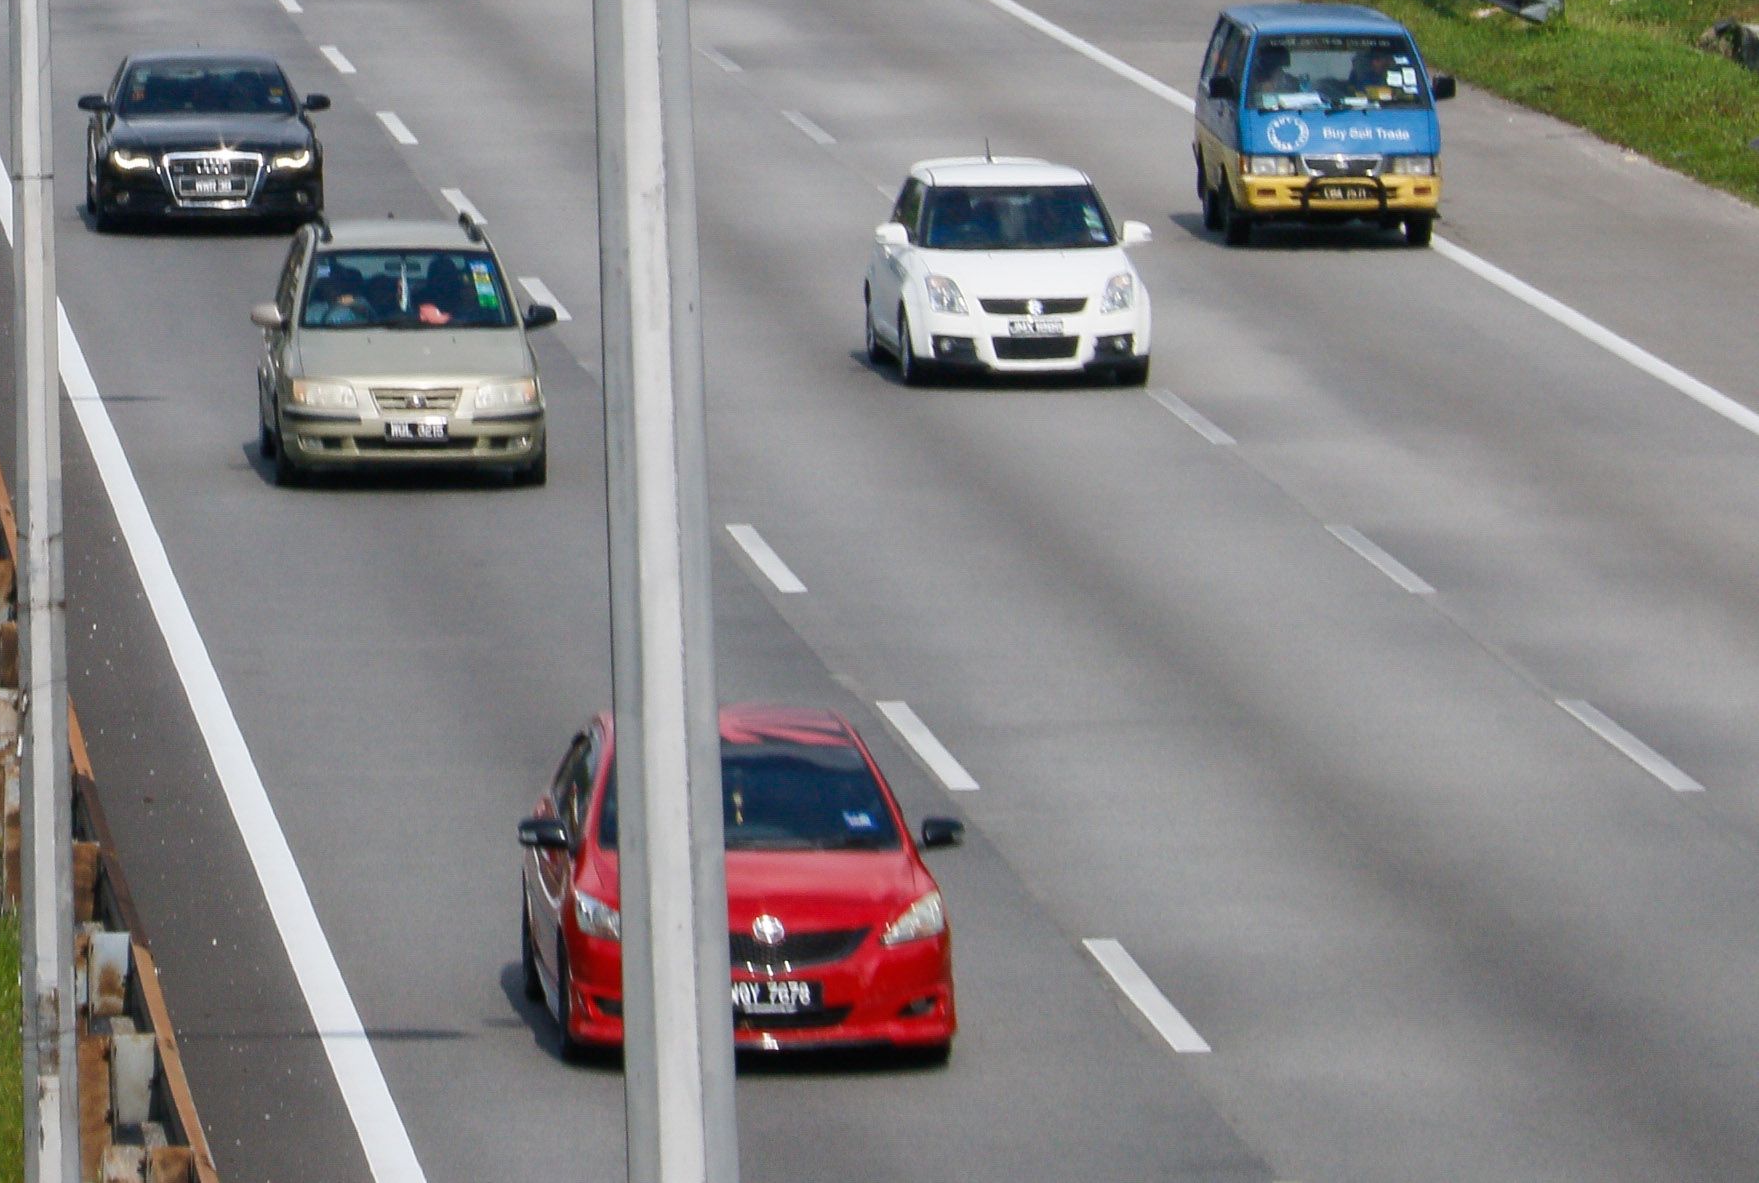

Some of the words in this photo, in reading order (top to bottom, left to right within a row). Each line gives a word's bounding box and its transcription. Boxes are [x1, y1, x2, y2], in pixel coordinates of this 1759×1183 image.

[1322, 127, 1346, 141] Buy
[1349, 127, 1373, 140] Sell
[1376, 127, 1410, 141] Trade
